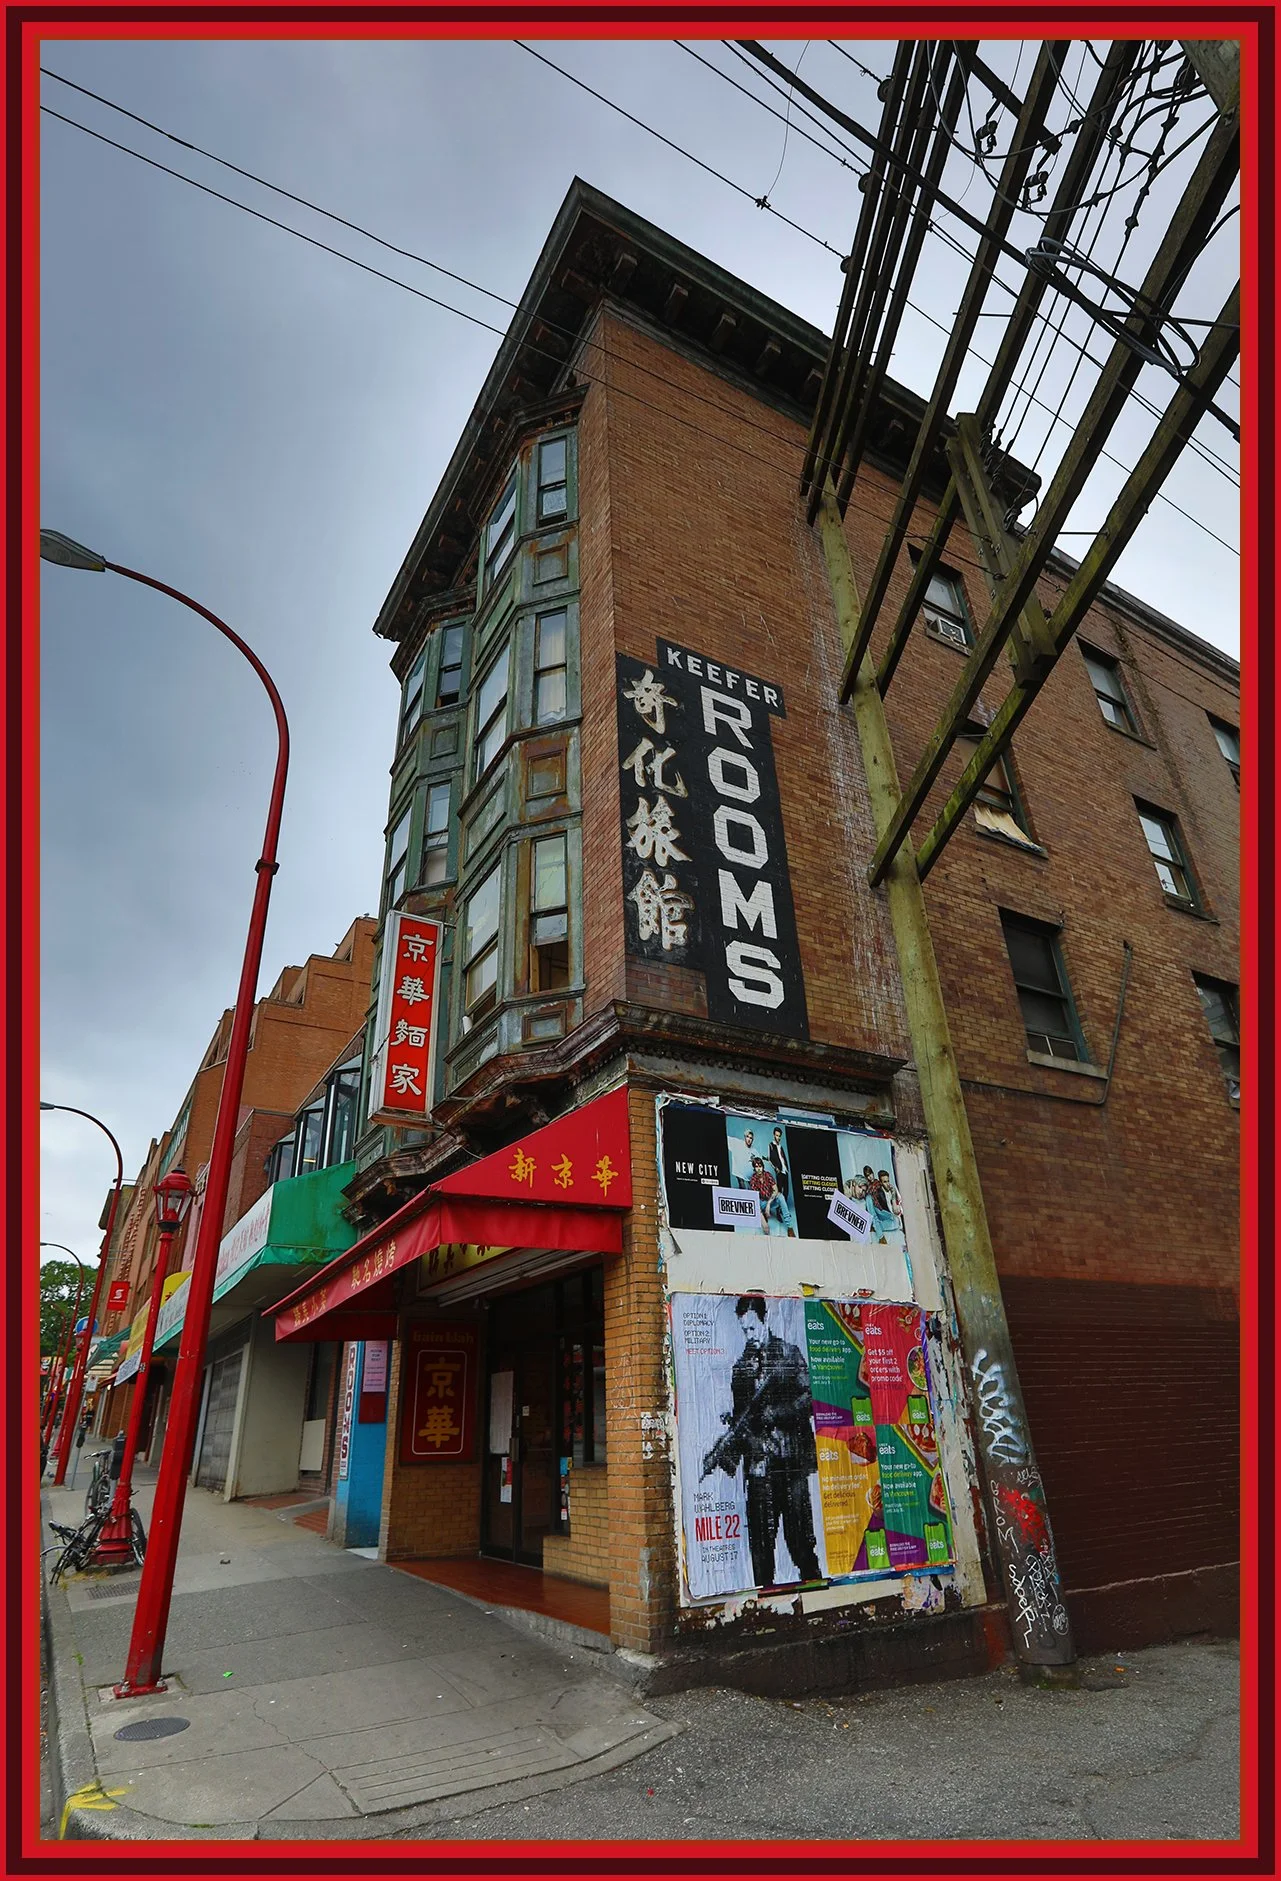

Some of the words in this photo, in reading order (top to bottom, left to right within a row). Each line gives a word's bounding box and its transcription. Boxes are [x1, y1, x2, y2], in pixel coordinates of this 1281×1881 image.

[667, 646, 779, 709] KEEFER
[622, 669, 695, 952] 奇化旅館
[700, 684, 785, 1011] ROOMS
[389, 934, 434, 1096] 京華麵家
[508, 1148, 619, 1198] 新京華
[675, 1161, 694, 1174] NEW
[698, 1163, 718, 1177] CITY
[720, 1199, 754, 1215] BREVNER
[836, 1203, 865, 1231] BREVNER
[807, 1321, 825, 1331] eats
[865, 1326, 883, 1336] eats
[867, 1348, 878, 1356] Get
[869, 1358, 881, 1366] your
[871, 1375, 889, 1383] promo
[418, 1356, 461, 1449] 京華
[820, 1450, 839, 1461] eats
[879, 1445, 896, 1455] eats
[693, 1492, 714, 1501] MARK
[693, 1501, 736, 1513] WAHLBERG
[695, 1516, 722, 1542] MILE
[725, 1514, 740, 1539] 22
[701, 1552, 729, 1563] AUGUST
[730, 1551, 738, 1561] 17
